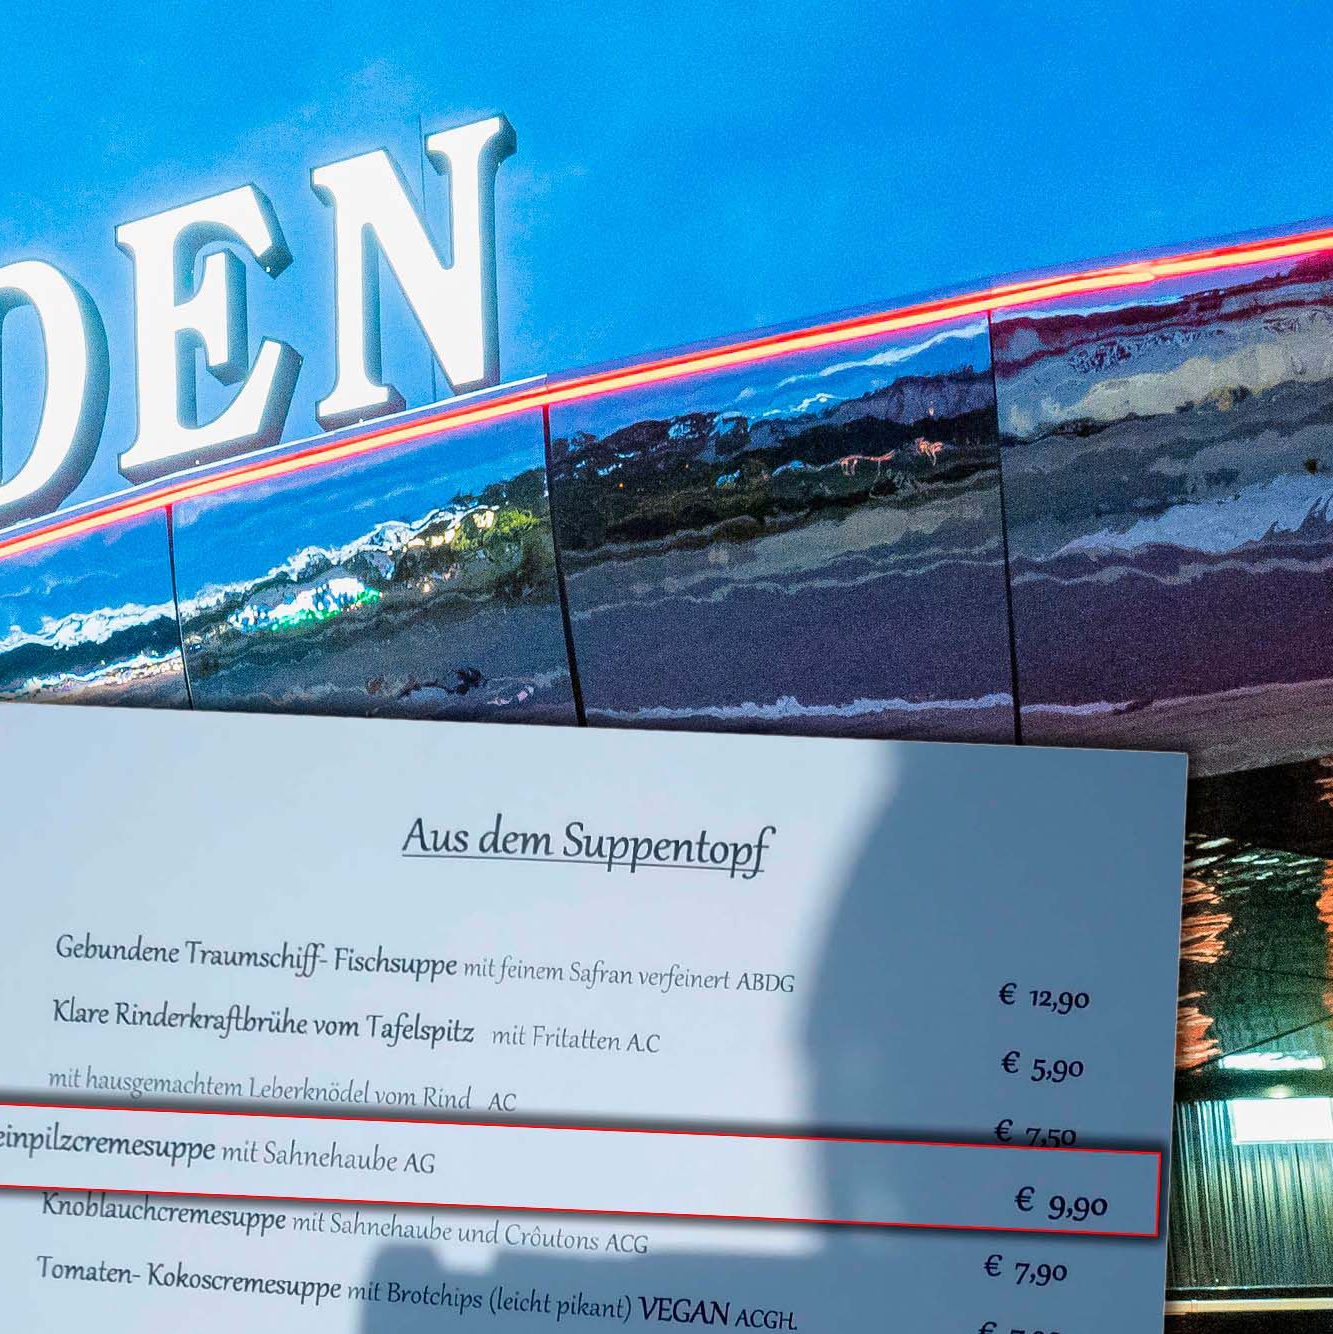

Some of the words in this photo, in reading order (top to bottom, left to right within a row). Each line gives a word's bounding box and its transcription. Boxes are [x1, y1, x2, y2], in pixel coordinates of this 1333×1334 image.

[402, 817, 469, 854] Aus
[478, 813, 554, 857] dem
[562, 820, 777, 879] Suppentopf
[56, 931, 180, 964] Gebundene
[184, 940, 328, 978] Traumschiff-
[334, 944, 458, 984] Fischsuppe
[464, 958, 495, 978] mit
[494, 954, 564, 985] feinem
[569, 960, 632, 990] Safran
[638, 963, 729, 994] verfeinert
[735, 972, 795, 993] ABDG
[998, 982, 1018, 1006] €
[1029, 990, 1090, 1016] 12,90
[52, 995, 110, 1025] Klare
[115, 1000, 308, 1040] Rinderkraftbrühe
[312, 1019, 360, 1037] vom
[365, 1011, 475, 1050] Tafelspitz
[492, 1024, 526, 1046] mit
[532, 1025, 620, 1051] Fritatten
[48, 1068, 80, 1089] mit
[85, 1064, 244, 1098] hausgemachtem
[249, 1075, 370, 1104] Leberknödel
[374, 1090, 417, 1106] vom
[423, 1085, 472, 1109] Rind
[487, 1092, 517, 1112] AC
[1000, 1050, 1021, 1074] €
[1030, 1058, 1084, 1084] 5,90
[994, 1117, 1014, 1142] €
[1024, 1126, 1078, 1148] 7,50
[222, 1140, 259, 1163] mit
[263, 1138, 398, 1172] Sahnehaube
[403, 1152, 436, 1174] AG
[42, 1192, 287, 1238] Knoblauchcremesuppe
[292, 1212, 324, 1233] mit
[330, 1210, 452, 1241] Sahnehaube
[458, 1220, 500, 1244] und
[504, 1223, 599, 1250] Crôutons
[605, 1233, 649, 1254] ACG
[1013, 1185, 1036, 1212] €
[1047, 1195, 1109, 1222] 9,90
[36, 1255, 142, 1284] Tomaten-
[147, 1261, 342, 1307] Kokoscremesuppe
[348, 1281, 381, 1302] mit
[387, 1281, 483, 1316] Brotchips
[489, 1285, 552, 1316] (leicht
[556, 1291, 632, 1324] pikant)
[637, 1296, 731, 1326] VEGAN
[983, 1254, 1003, 1278] €
[1014, 1262, 1068, 1287] 7,90
